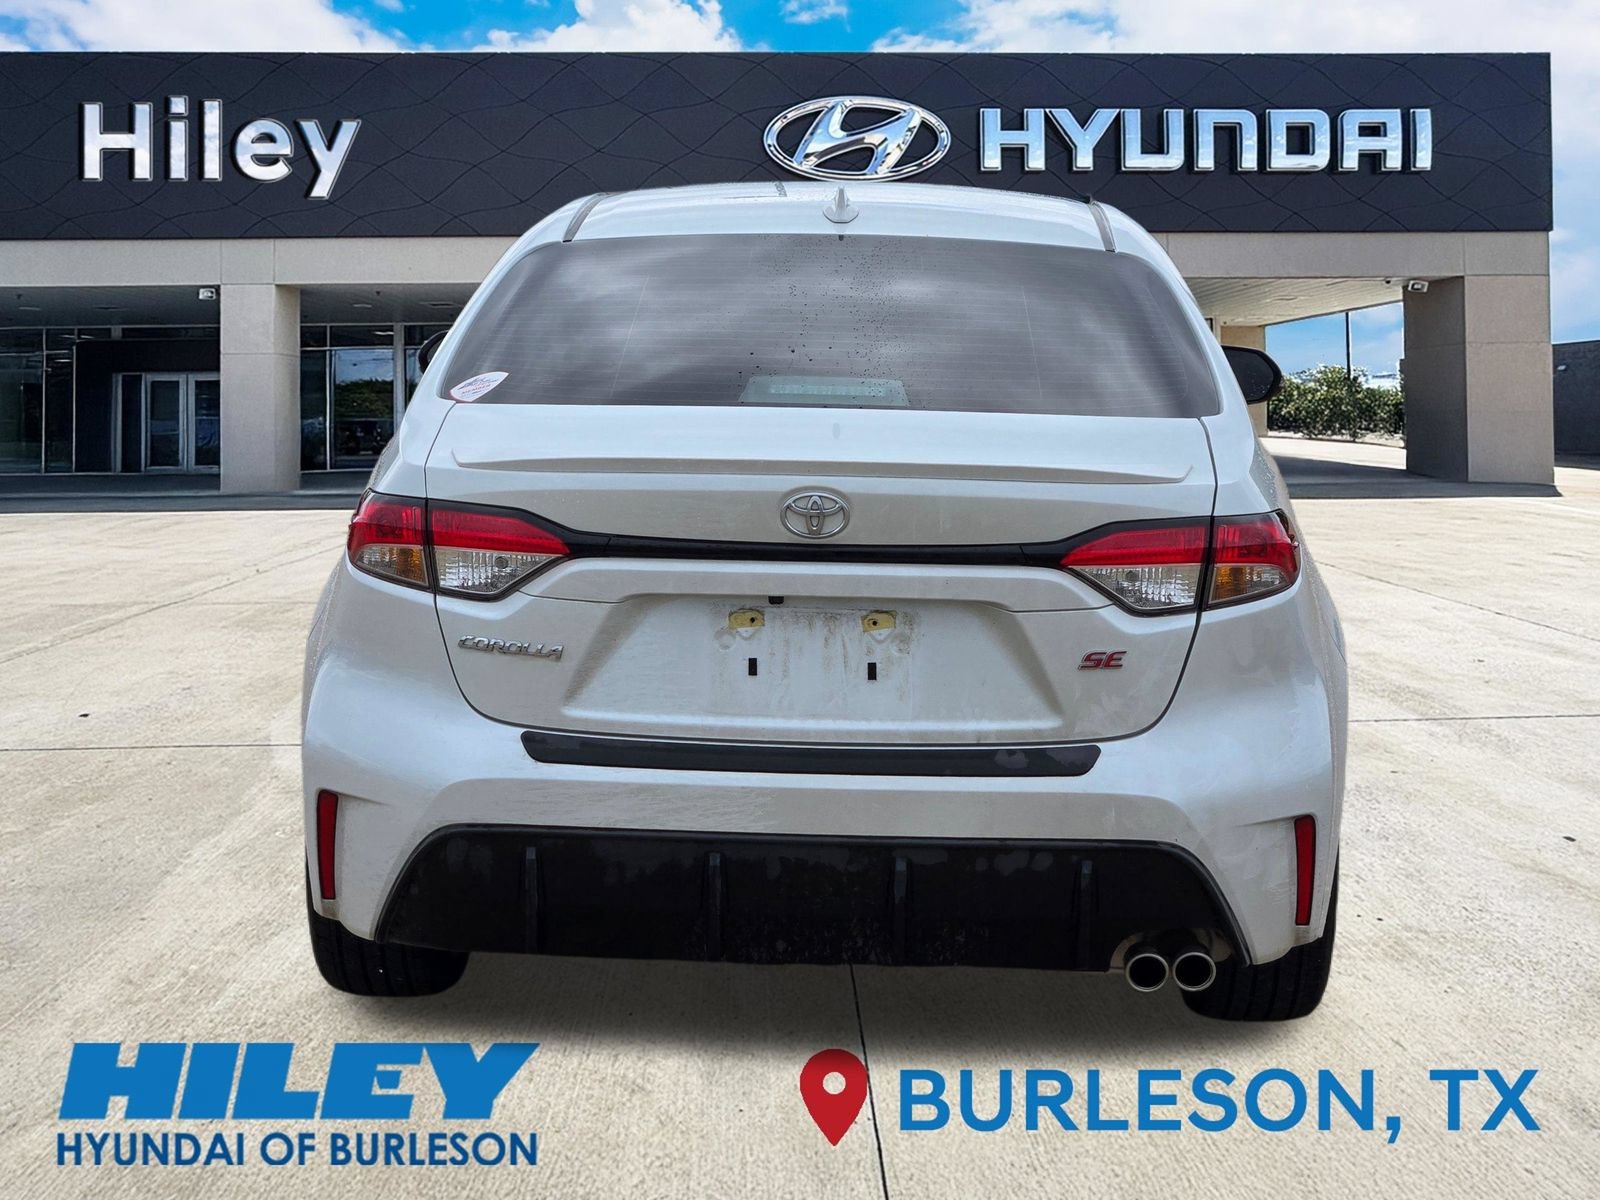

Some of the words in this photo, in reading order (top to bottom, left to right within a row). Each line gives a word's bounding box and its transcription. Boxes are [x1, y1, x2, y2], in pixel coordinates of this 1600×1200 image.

[80, 95, 361, 200] Hiley
[979, 107, 1432, 172] HYUNDAI
[458, 635, 563, 661] COROLLA
[1079, 650, 1127, 671] SE
